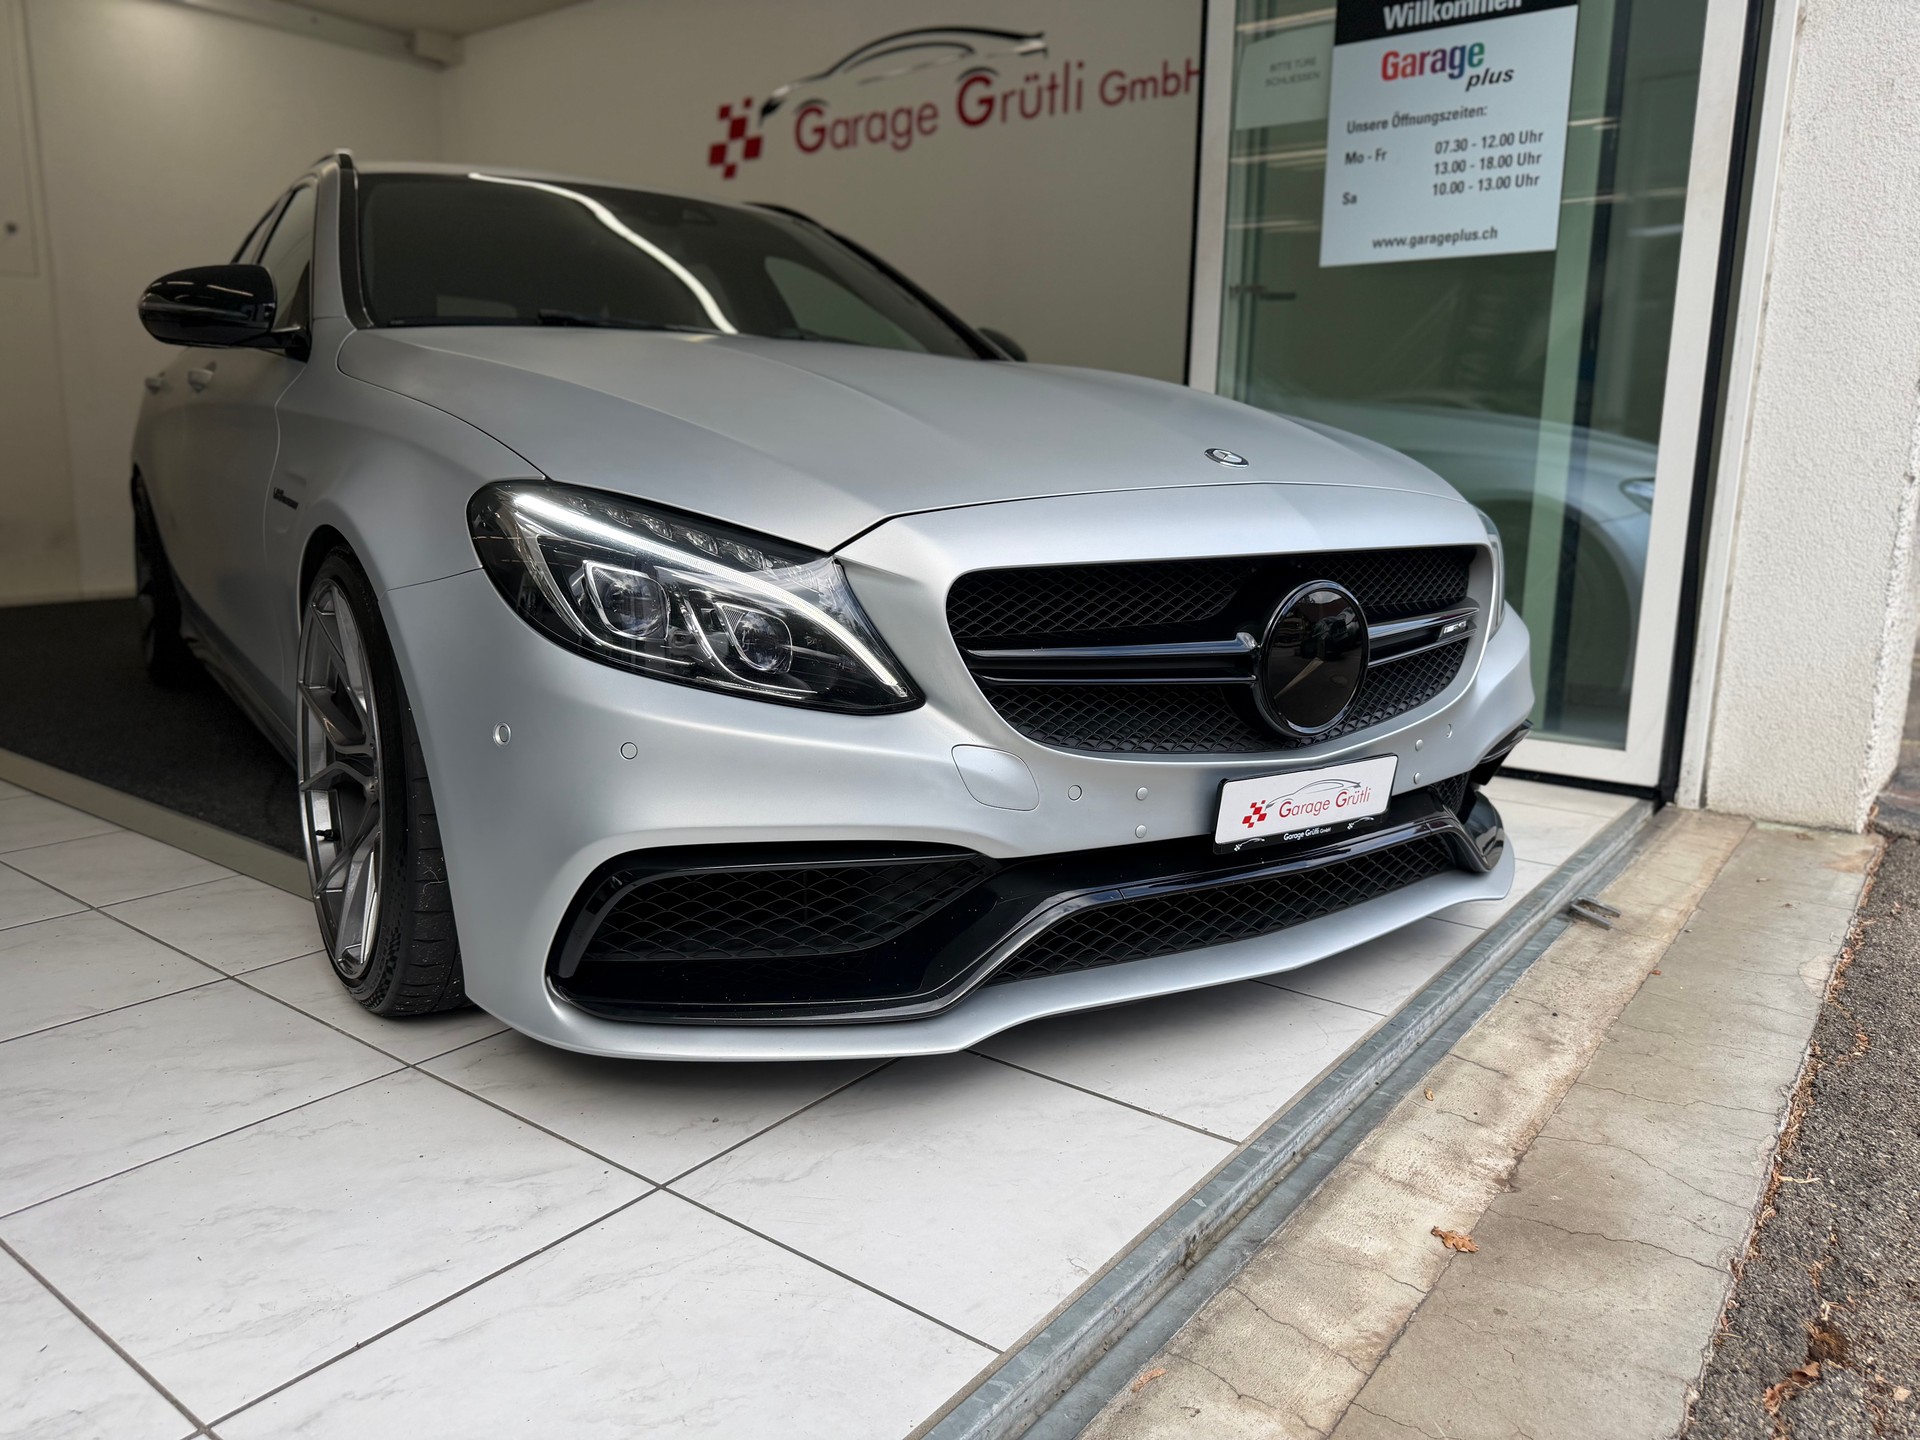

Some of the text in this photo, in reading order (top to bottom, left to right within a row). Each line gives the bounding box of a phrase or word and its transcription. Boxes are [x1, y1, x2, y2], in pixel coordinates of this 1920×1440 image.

[1381, 41, 1485, 81] Garage
[1465, 68, 1515, 92] plus
[795, 58, 1199, 154] Garage Grütli GmbH
[1346, 105, 1488, 134] Unsere Öffnungszeiten:
[1434, 138, 1469, 155] 07.30
[1481, 132, 1516, 150] 12.00
[1518, 129, 1544, 146] Uhr
[1344, 151, 1365, 166] Mo
[1374, 148, 1388, 163] Fr
[1434, 159, 1467, 176] 13.00
[1479, 154, 1514, 171] 18.00
[1516, 151, 1542, 167] Uhr
[1433, 180, 1466, 197] 10.00
[1478, 175, 1512, 193] 13.00
[1514, 173, 1540, 189] Uhr
[1342, 192, 1358, 206] Sa
[1372, 226, 1498, 249] www.garageplus.ch
[1278, 786, 1372, 818] Garage Grütli
[1283, 832, 1305, 841] Garage
